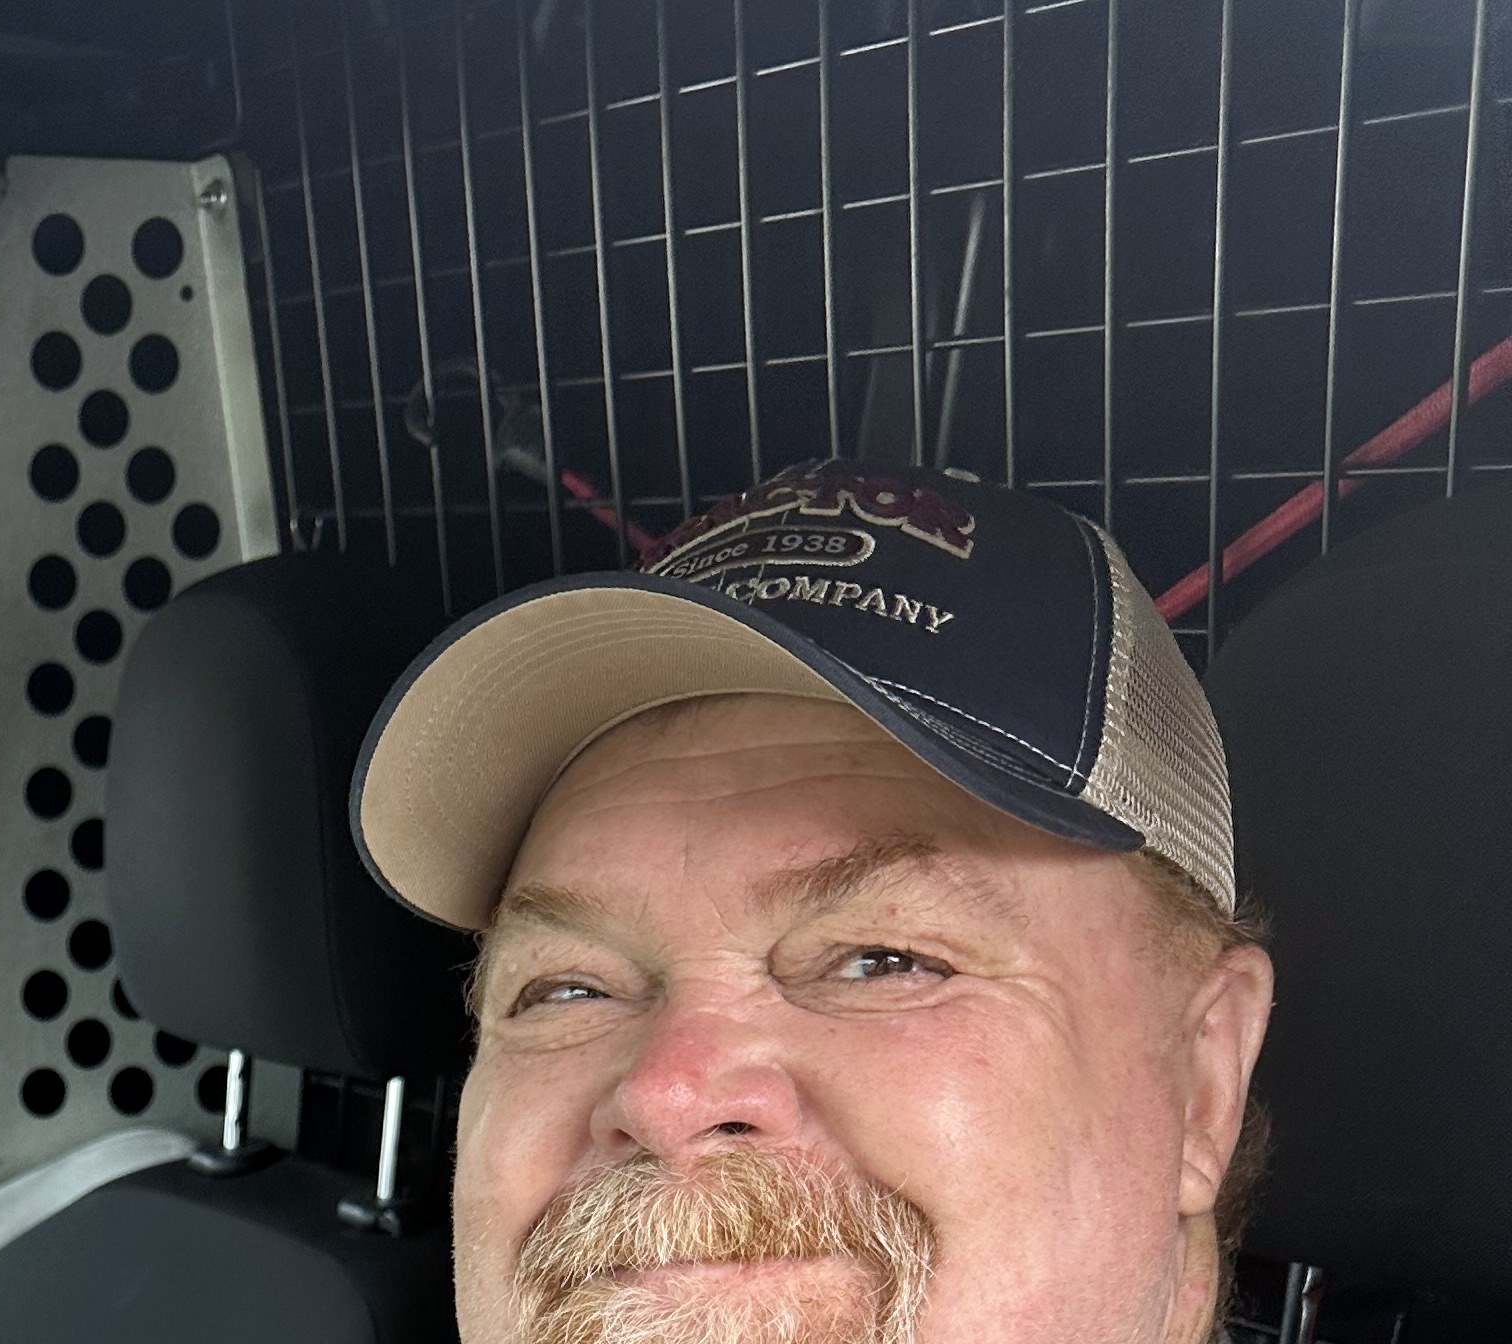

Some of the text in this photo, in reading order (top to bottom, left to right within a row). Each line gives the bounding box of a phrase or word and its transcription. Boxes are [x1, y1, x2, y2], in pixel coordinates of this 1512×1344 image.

[671, 533, 847, 579] Since 1938
[725, 575, 955, 634] COMPANY
